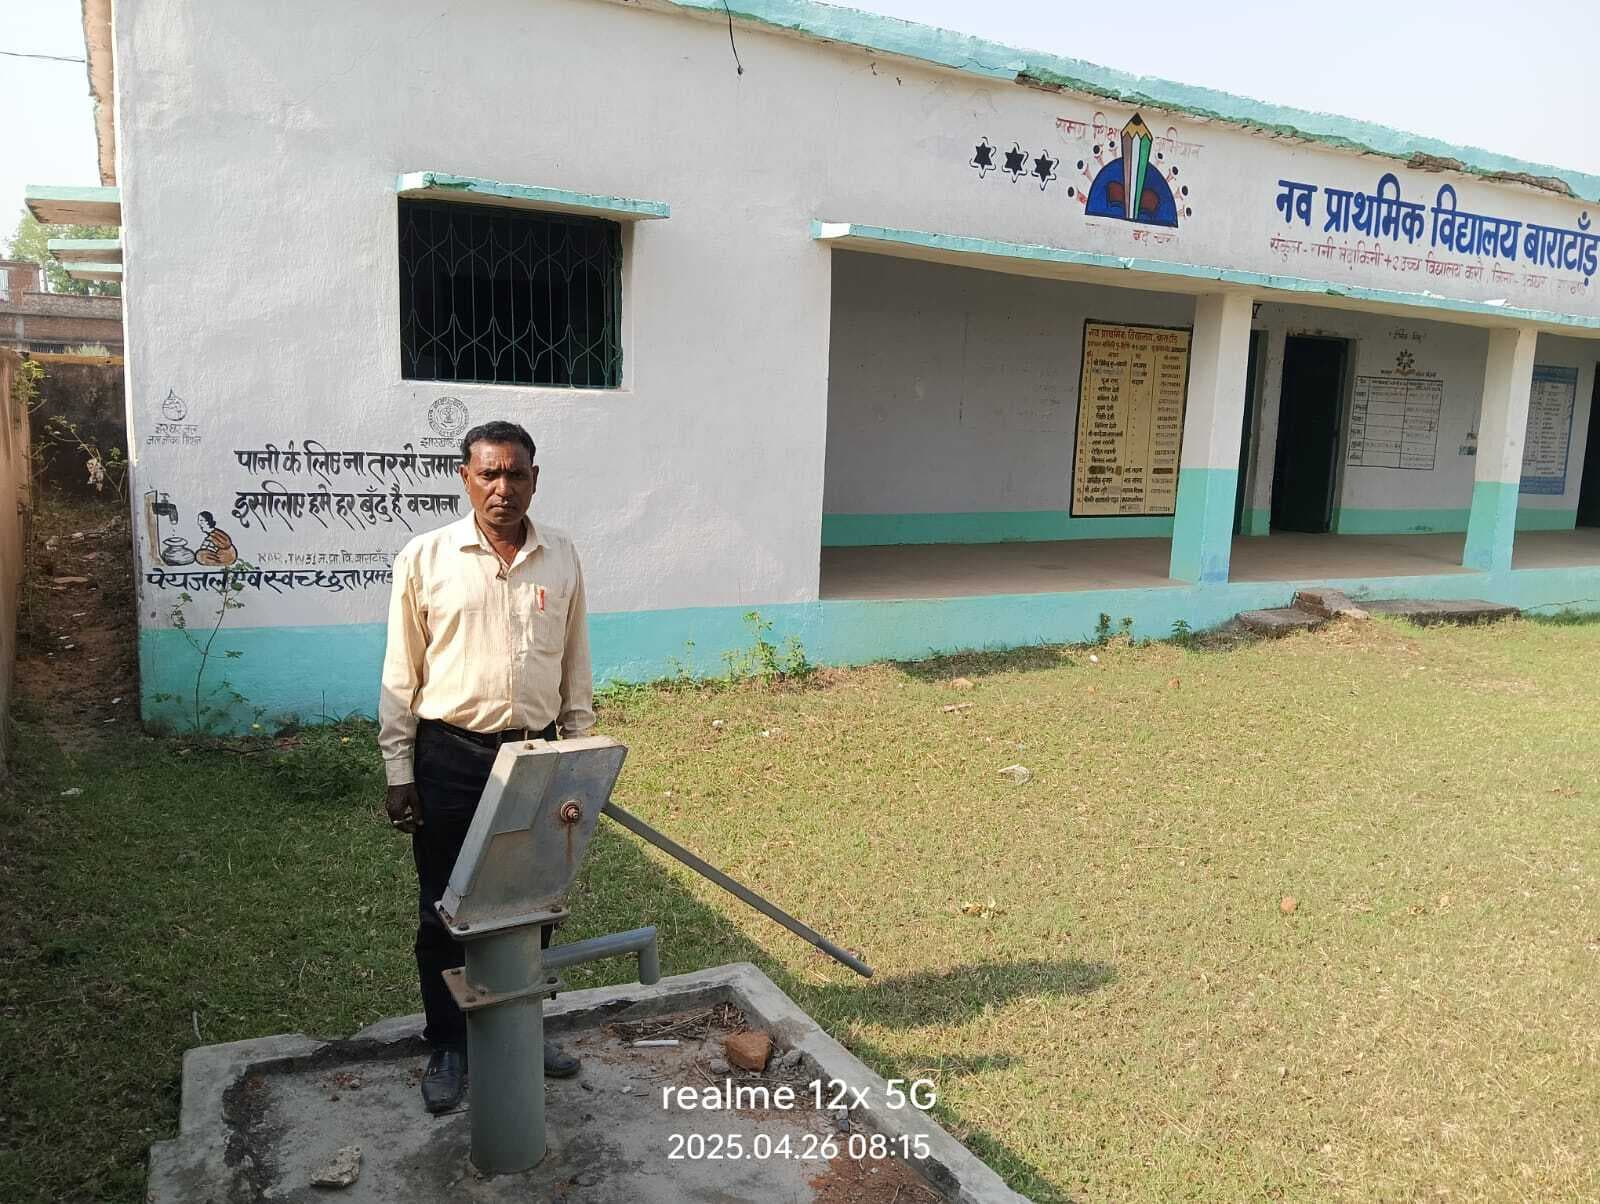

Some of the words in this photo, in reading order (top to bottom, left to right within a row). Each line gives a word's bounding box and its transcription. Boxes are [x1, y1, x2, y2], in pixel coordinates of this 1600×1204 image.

[1276, 179, 1318, 227] नव
[1323, 172, 1426, 245] प्राथमिक
[1431, 183, 1522, 262] विद्यालय
[233, 443, 281, 475] पानी
[281, 440, 301, 476] के
[303, 440, 341, 486] लिए
[341, 451, 366, 477] ना
[232, 480, 306, 532] इसलिए
[332, 493, 366, 530] हर
[389, 483, 413, 532] है
[404, 494, 462, 517] बचाना
[144, 568, 229, 595] पेयजल
